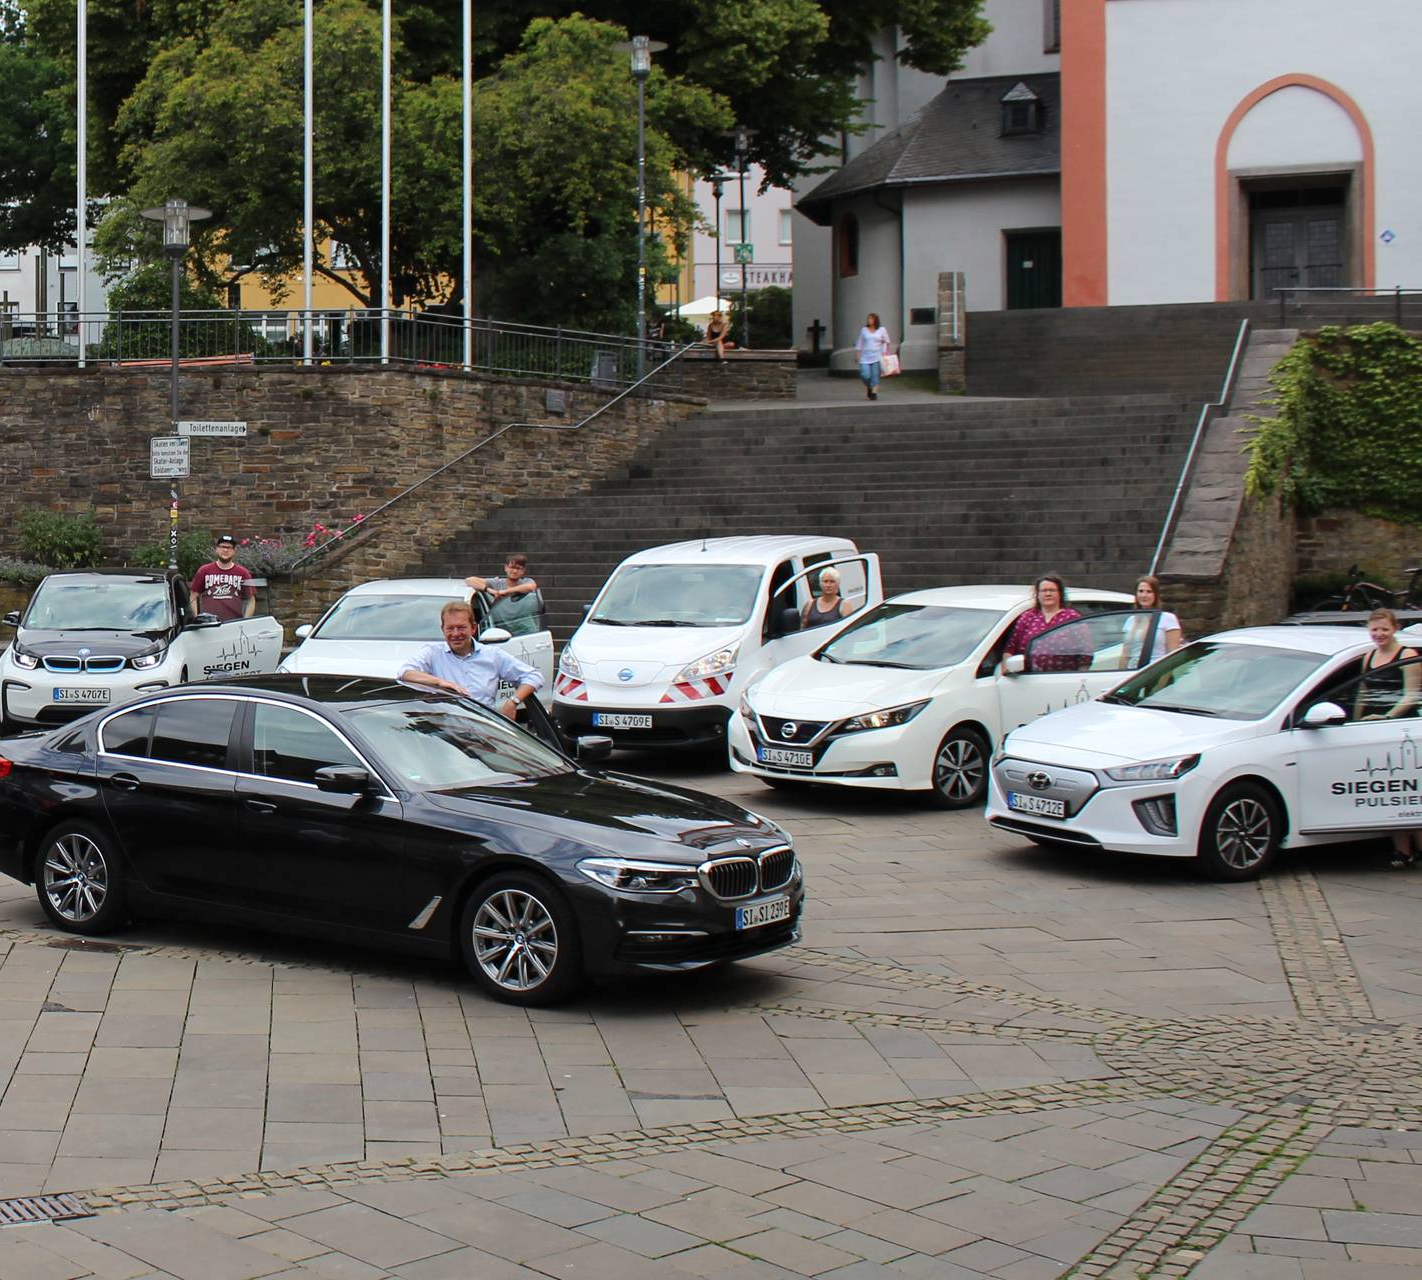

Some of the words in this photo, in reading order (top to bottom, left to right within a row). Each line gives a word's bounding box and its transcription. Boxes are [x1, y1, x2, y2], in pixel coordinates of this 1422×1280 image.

[189, 423, 243, 434] Toilettenanlage
[205, 574, 242, 590] COMEBACK
[82, 689, 108, 699] 4707E
[622, 716, 651, 727] 4709E
[784, 752, 811, 766] 4710E
[1331, 779, 1418, 795] SIEGEN
[1036, 800, 1063, 816] 4712E
[1355, 795, 1422, 807] PULSIE
[743, 909, 754, 926] SI
[759, 905, 769, 922] SI
[770, 900, 790, 919] 239E
